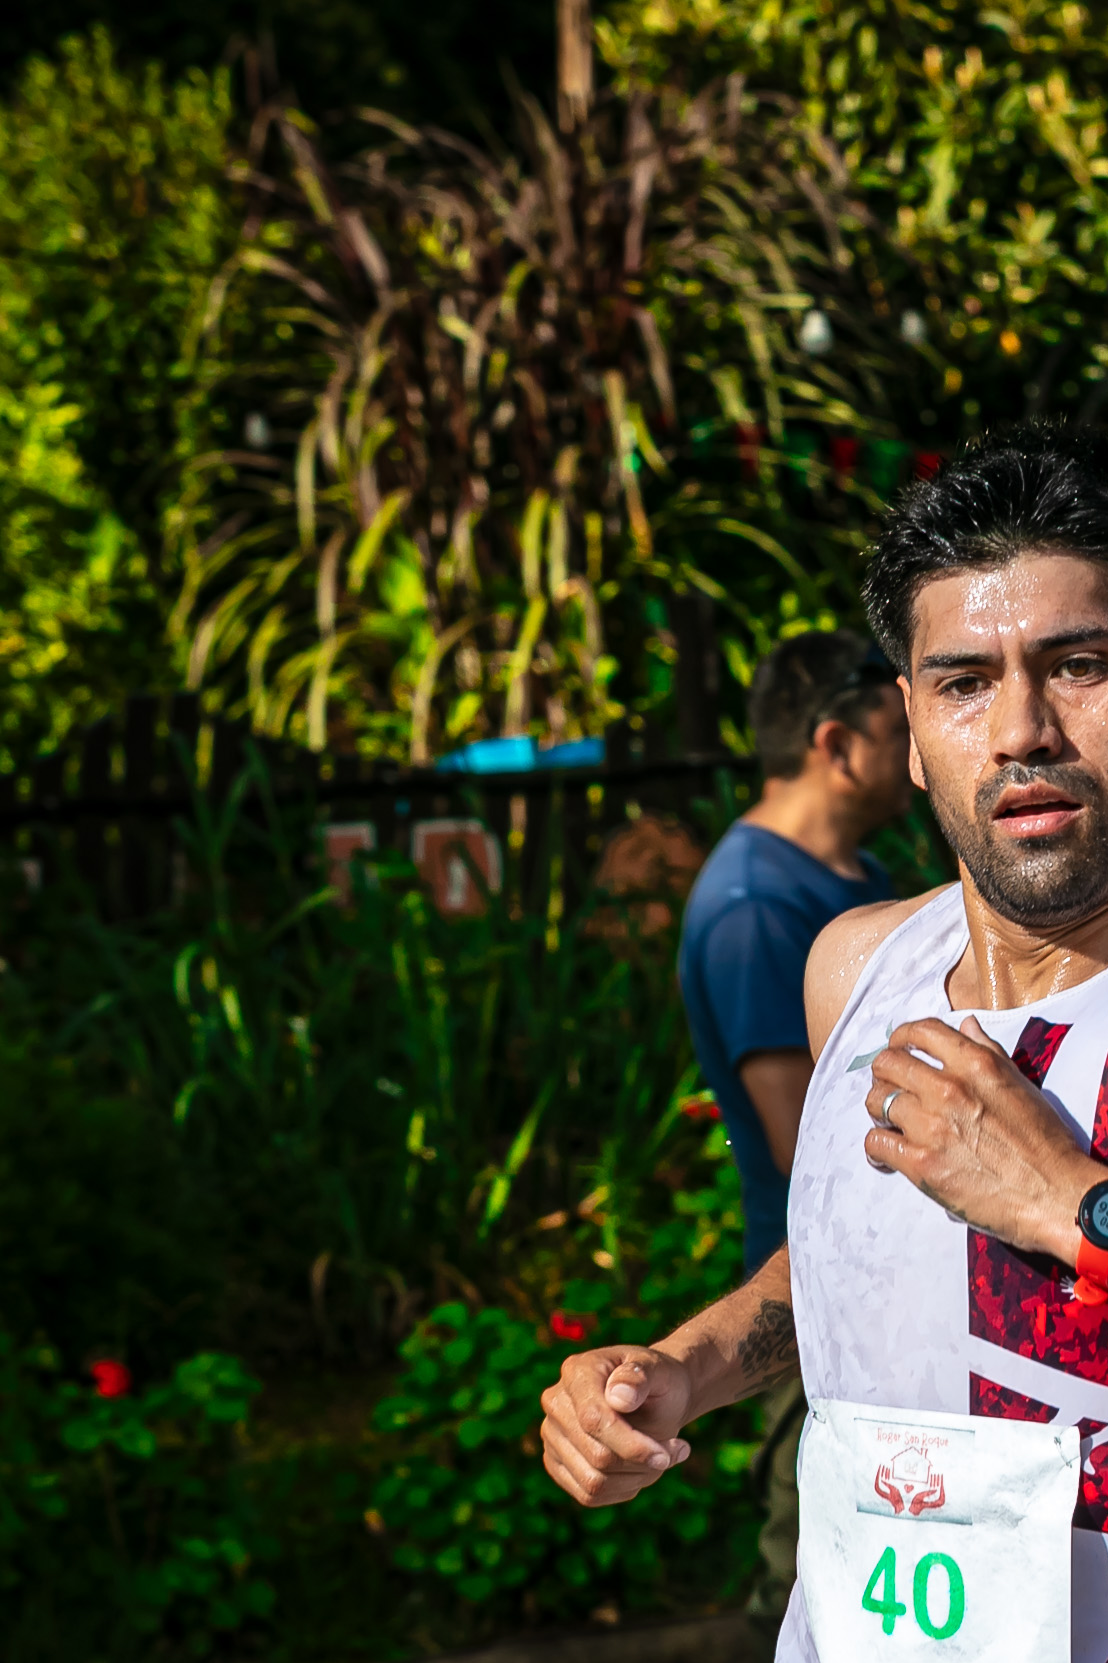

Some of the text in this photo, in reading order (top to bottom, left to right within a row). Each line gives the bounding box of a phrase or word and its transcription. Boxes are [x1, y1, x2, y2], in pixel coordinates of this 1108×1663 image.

[877, 1427, 949, 1448] Hogar San Roque
[862, 1546, 965, 1640] 40
